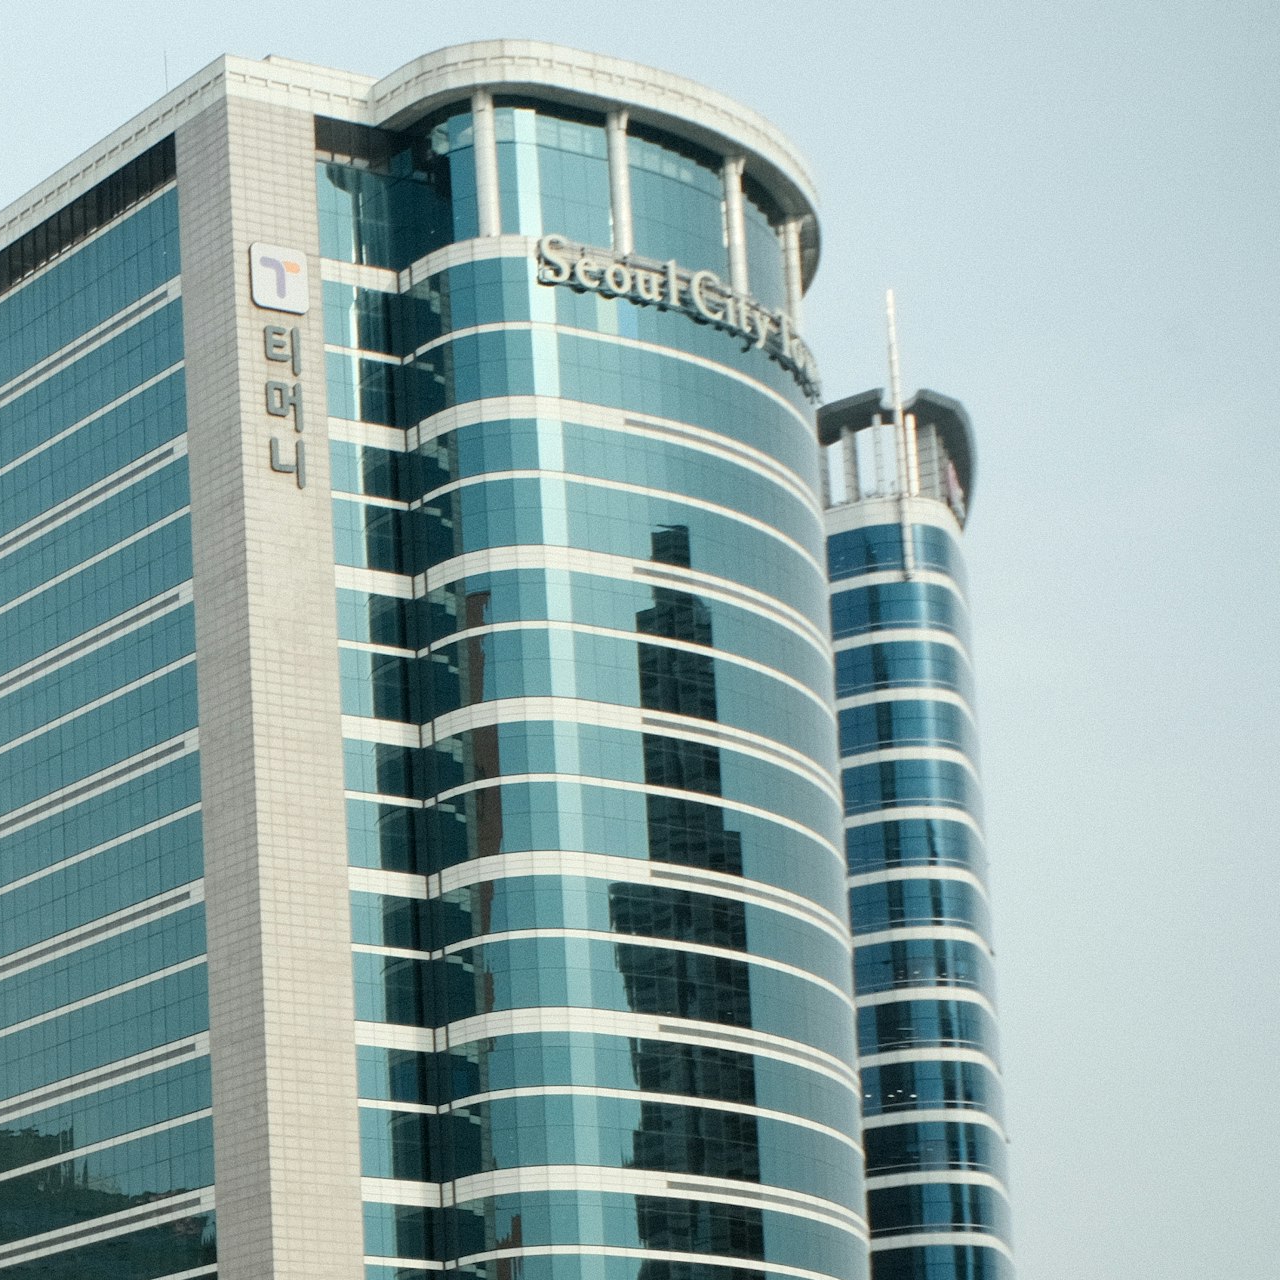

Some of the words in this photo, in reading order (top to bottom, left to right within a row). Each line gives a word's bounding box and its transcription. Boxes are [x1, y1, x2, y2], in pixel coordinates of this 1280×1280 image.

[539, 234, 680, 306] Seoul
[691, 270, 771, 349] City
[264, 325, 307, 490] 티머니
